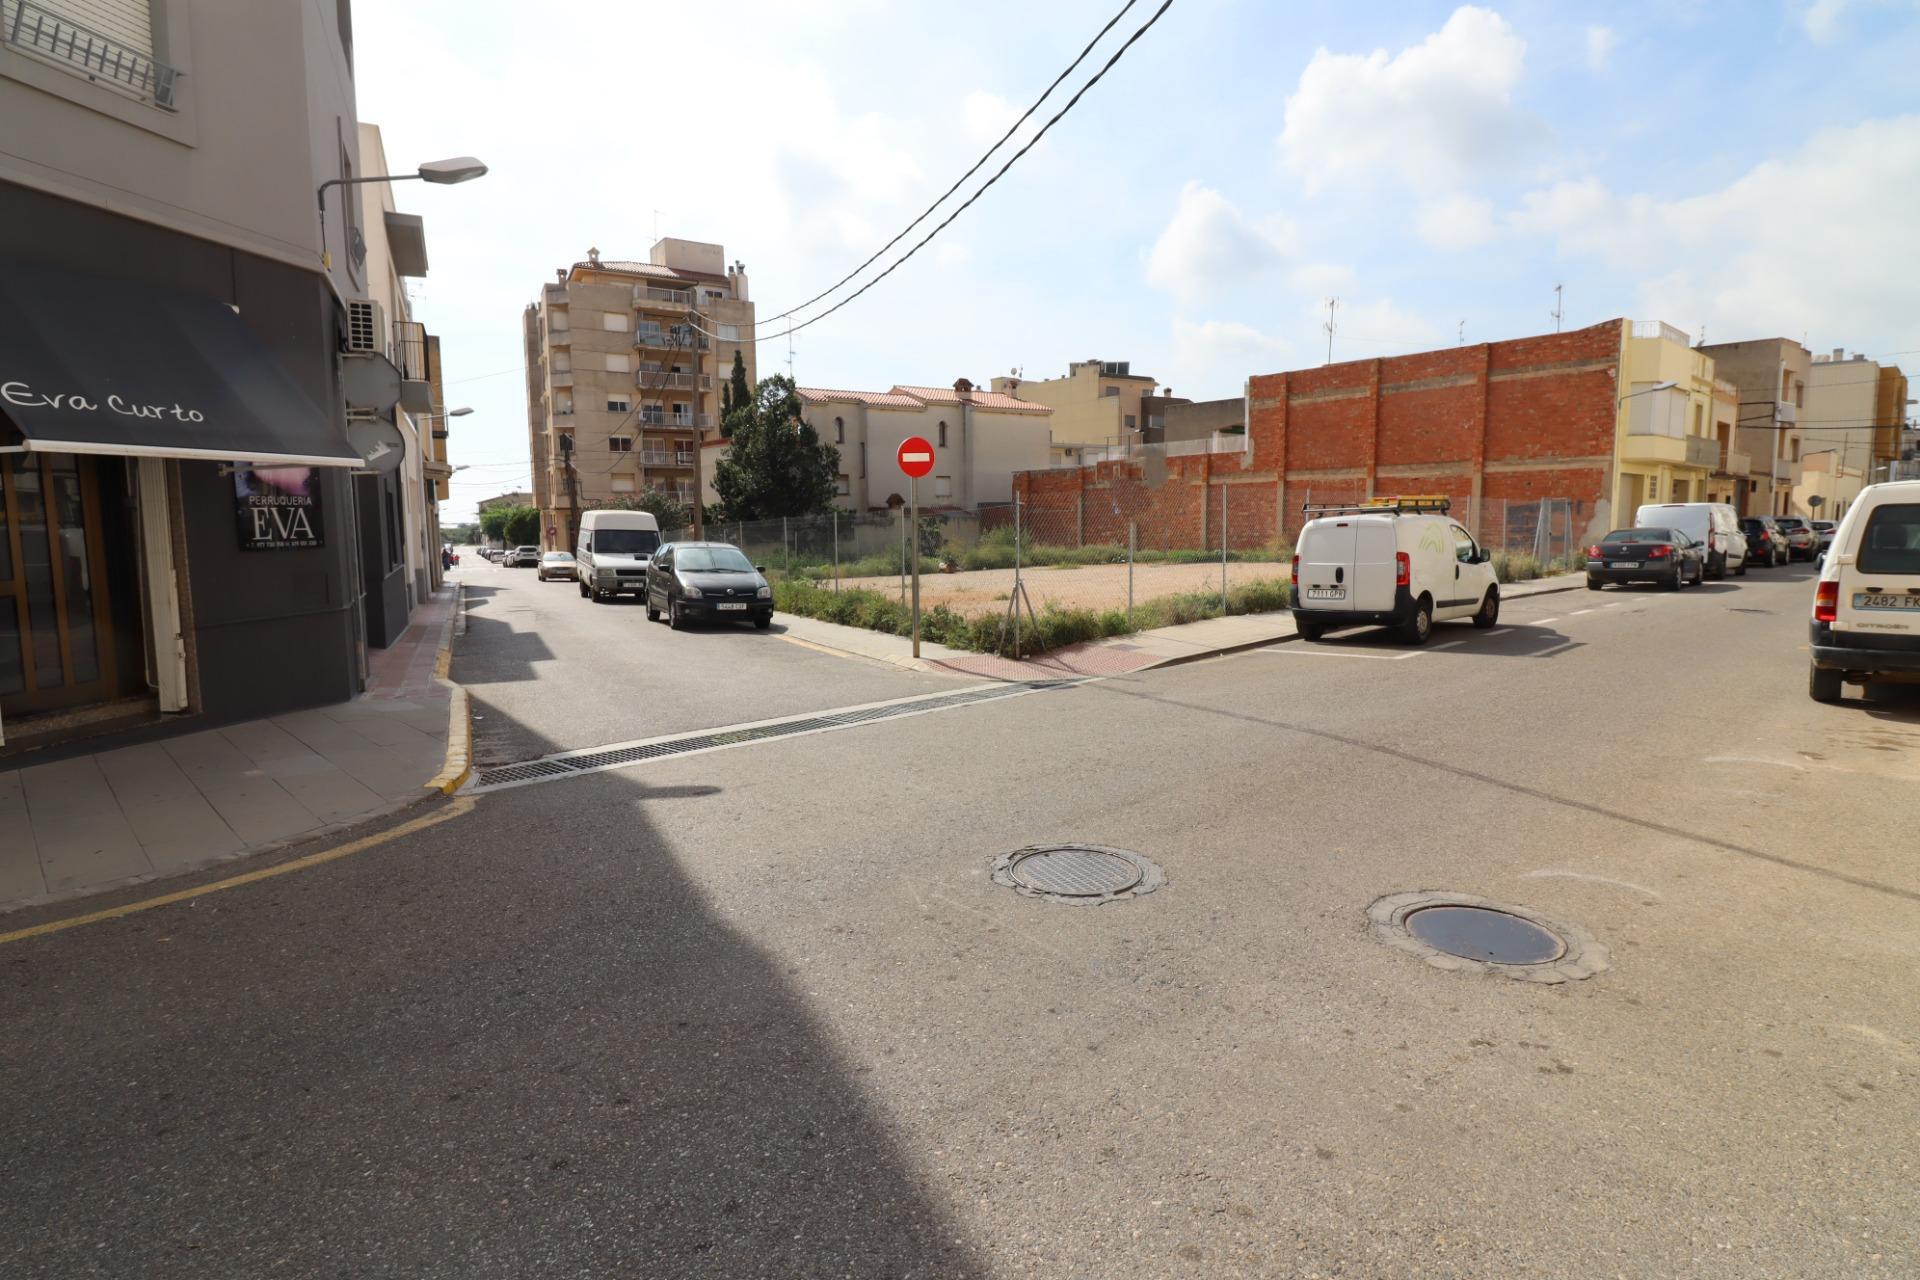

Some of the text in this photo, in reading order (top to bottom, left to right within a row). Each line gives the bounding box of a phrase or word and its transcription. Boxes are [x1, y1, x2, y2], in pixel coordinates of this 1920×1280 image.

[1, 382, 204, 422] Eva Curto
[248, 495, 313, 506] PERRUQUERIA
[249, 507, 315, 540] EVA
[1863, 595, 1897, 607] 2482
